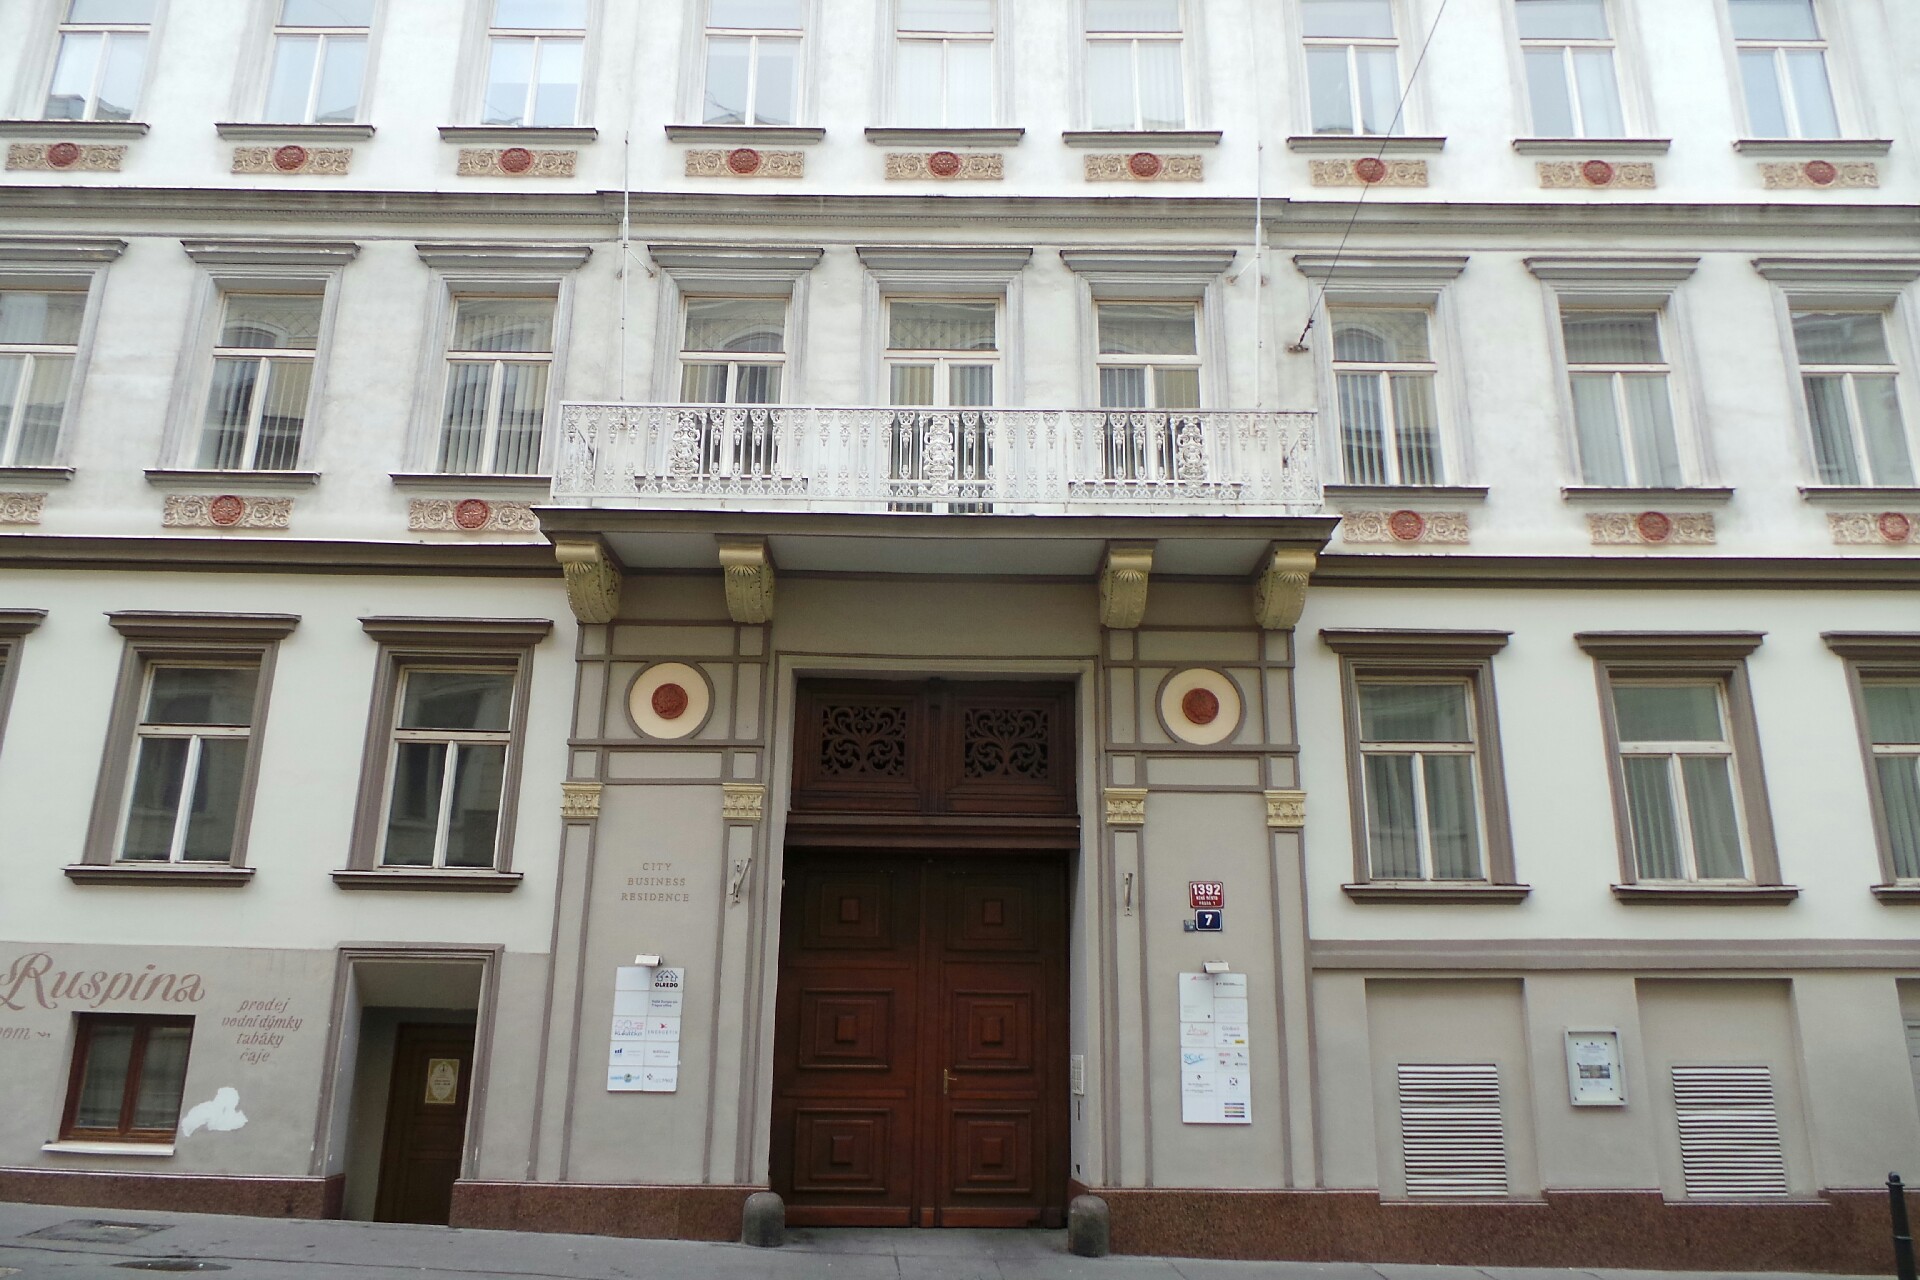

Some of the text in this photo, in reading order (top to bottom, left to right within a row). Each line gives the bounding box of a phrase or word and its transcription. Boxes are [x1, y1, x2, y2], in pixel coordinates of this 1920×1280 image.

[642, 862, 672, 871] CITY
[627, 877, 686, 886] BUSINESS
[1193, 884, 1220, 895] 1392
[621, 892, 689, 902] RESIDENCE
[1205, 914, 1212, 926] 7
[0, 951, 205, 1010] Ruspina
[237, 998, 291, 1013] prodej
[221, 1014, 303, 1031] vodní dýmky
[237, 1031, 284, 1048] tabáky
[240, 1048, 270, 1065] čaje
